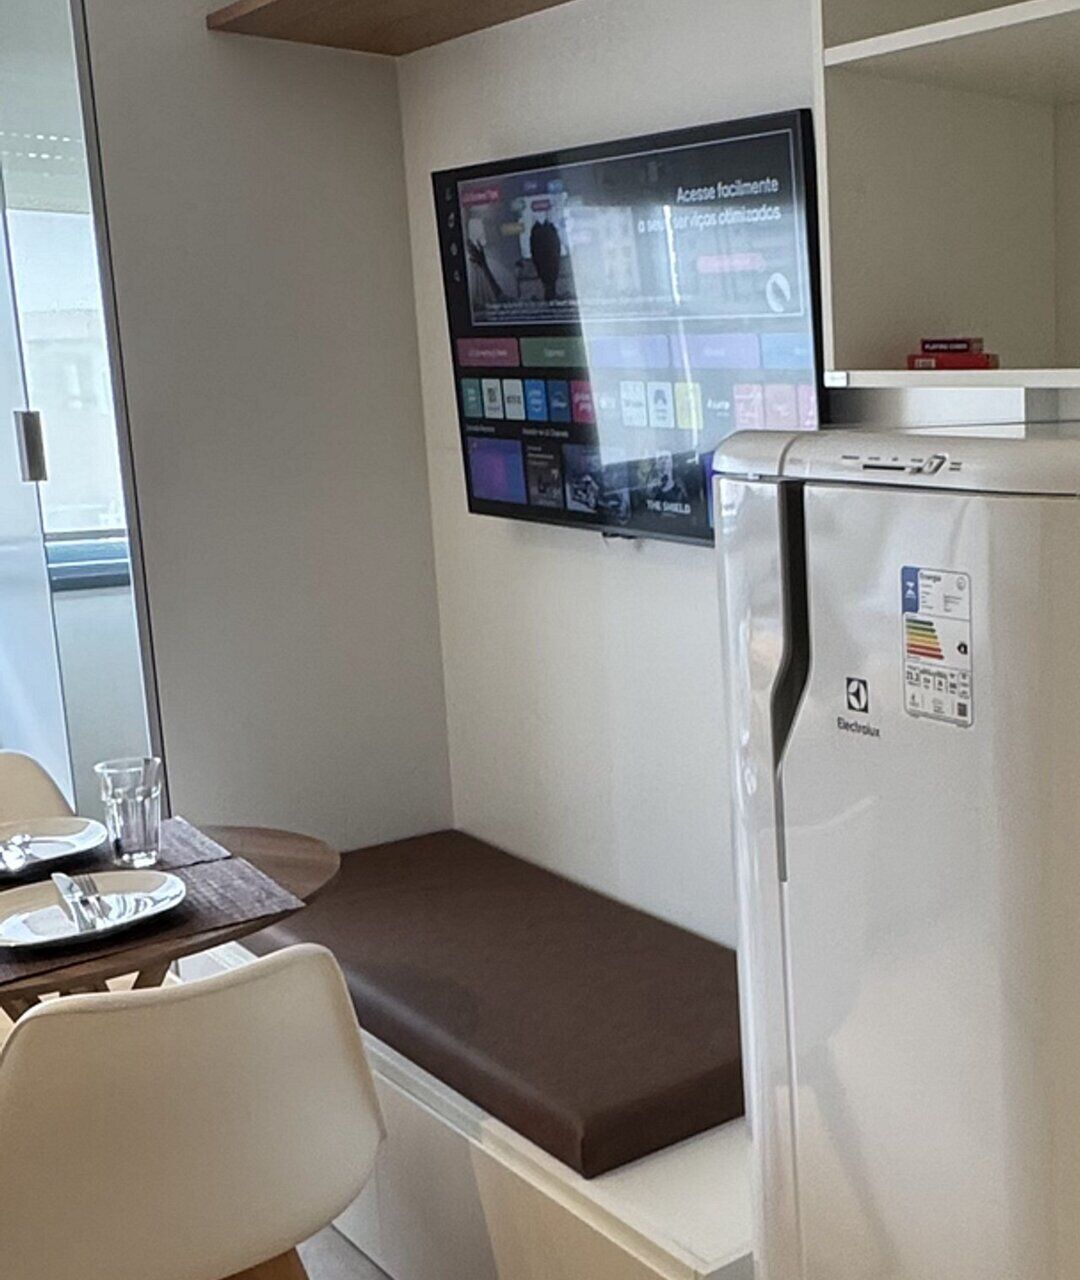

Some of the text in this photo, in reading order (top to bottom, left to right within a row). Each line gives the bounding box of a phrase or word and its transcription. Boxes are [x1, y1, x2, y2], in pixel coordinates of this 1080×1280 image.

[677, 177, 779, 203] Acesse facilmente
[837, 716, 880, 738] Electrolux
